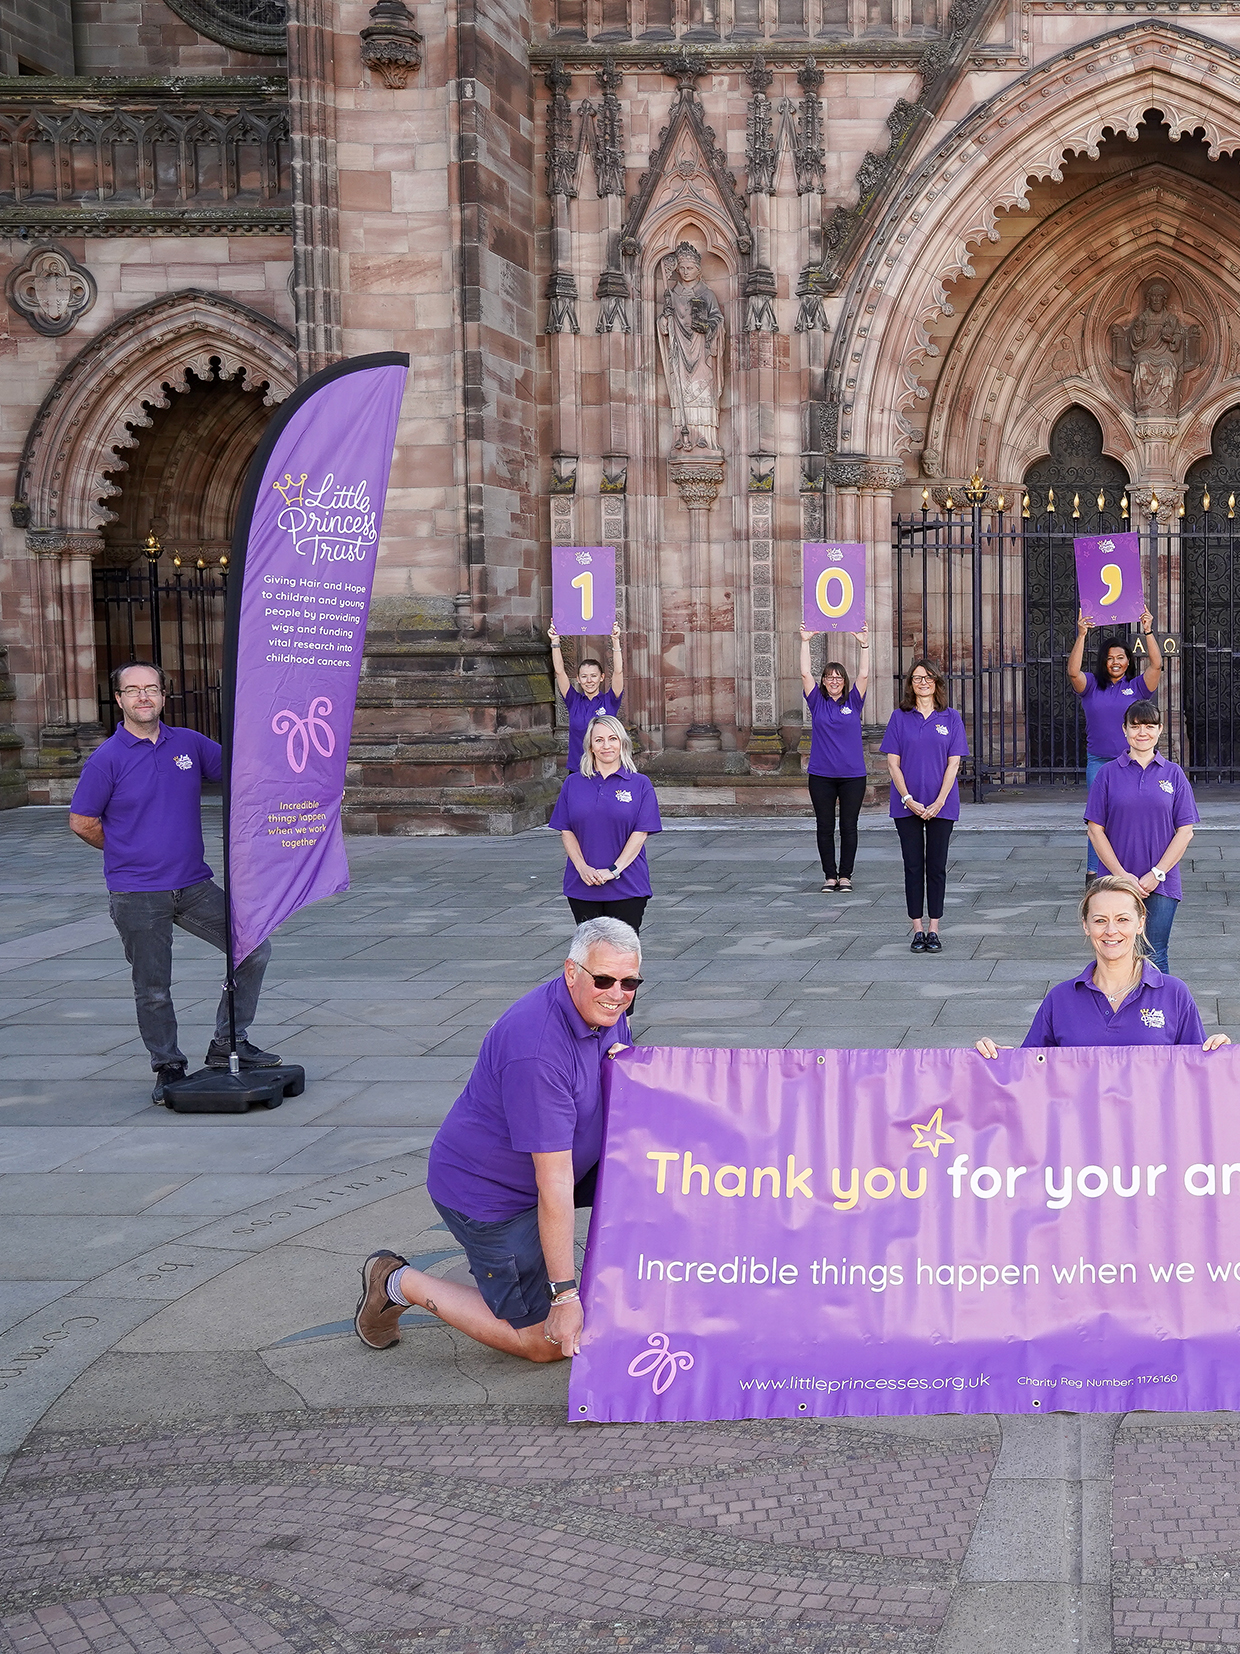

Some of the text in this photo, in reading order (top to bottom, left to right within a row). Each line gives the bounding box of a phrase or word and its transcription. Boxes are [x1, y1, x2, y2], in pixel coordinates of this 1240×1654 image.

[305, 473, 370, 513] Little
[278, 506, 377, 545] Princess
[296, 534, 366, 565] Trust
[263, 574, 366, 594] Giving Hair and Hope
[815, 567, 854, 618] 0
[262, 590, 365, 610] to children and young
[571, 571, 593, 621] 1
[265, 607, 361, 624] people by providing
[271, 622, 354, 638] wigs and funding
[269, 637, 353, 652] vital research into
[266, 653, 352, 667] childhood cancers.
[279, 800, 320, 810] Incredible
[267, 813, 297, 824] things
[268, 824, 327, 835] when we work
[281, 837, 318, 848] together
[646, 1150, 814, 1199] Thank
[831, 1165, 928, 1210] you
[947, 1154, 1027, 1199] for
[1044, 1163, 1167, 1210] your
[136, 1261, 195, 1282] be
[637, 1253, 799, 1287] Incredible
[810, 1257, 904, 1293] things
[916, 1258, 1040, 1292] happen
[1051, 1256, 1138, 1285] when
[1149, 1262, 1196, 1283] we
[739, 1373, 991, 1394] www.littleprincesses.org.uk
[1017, 1374, 1178, 1389] Charity Reg Number: 1176160
